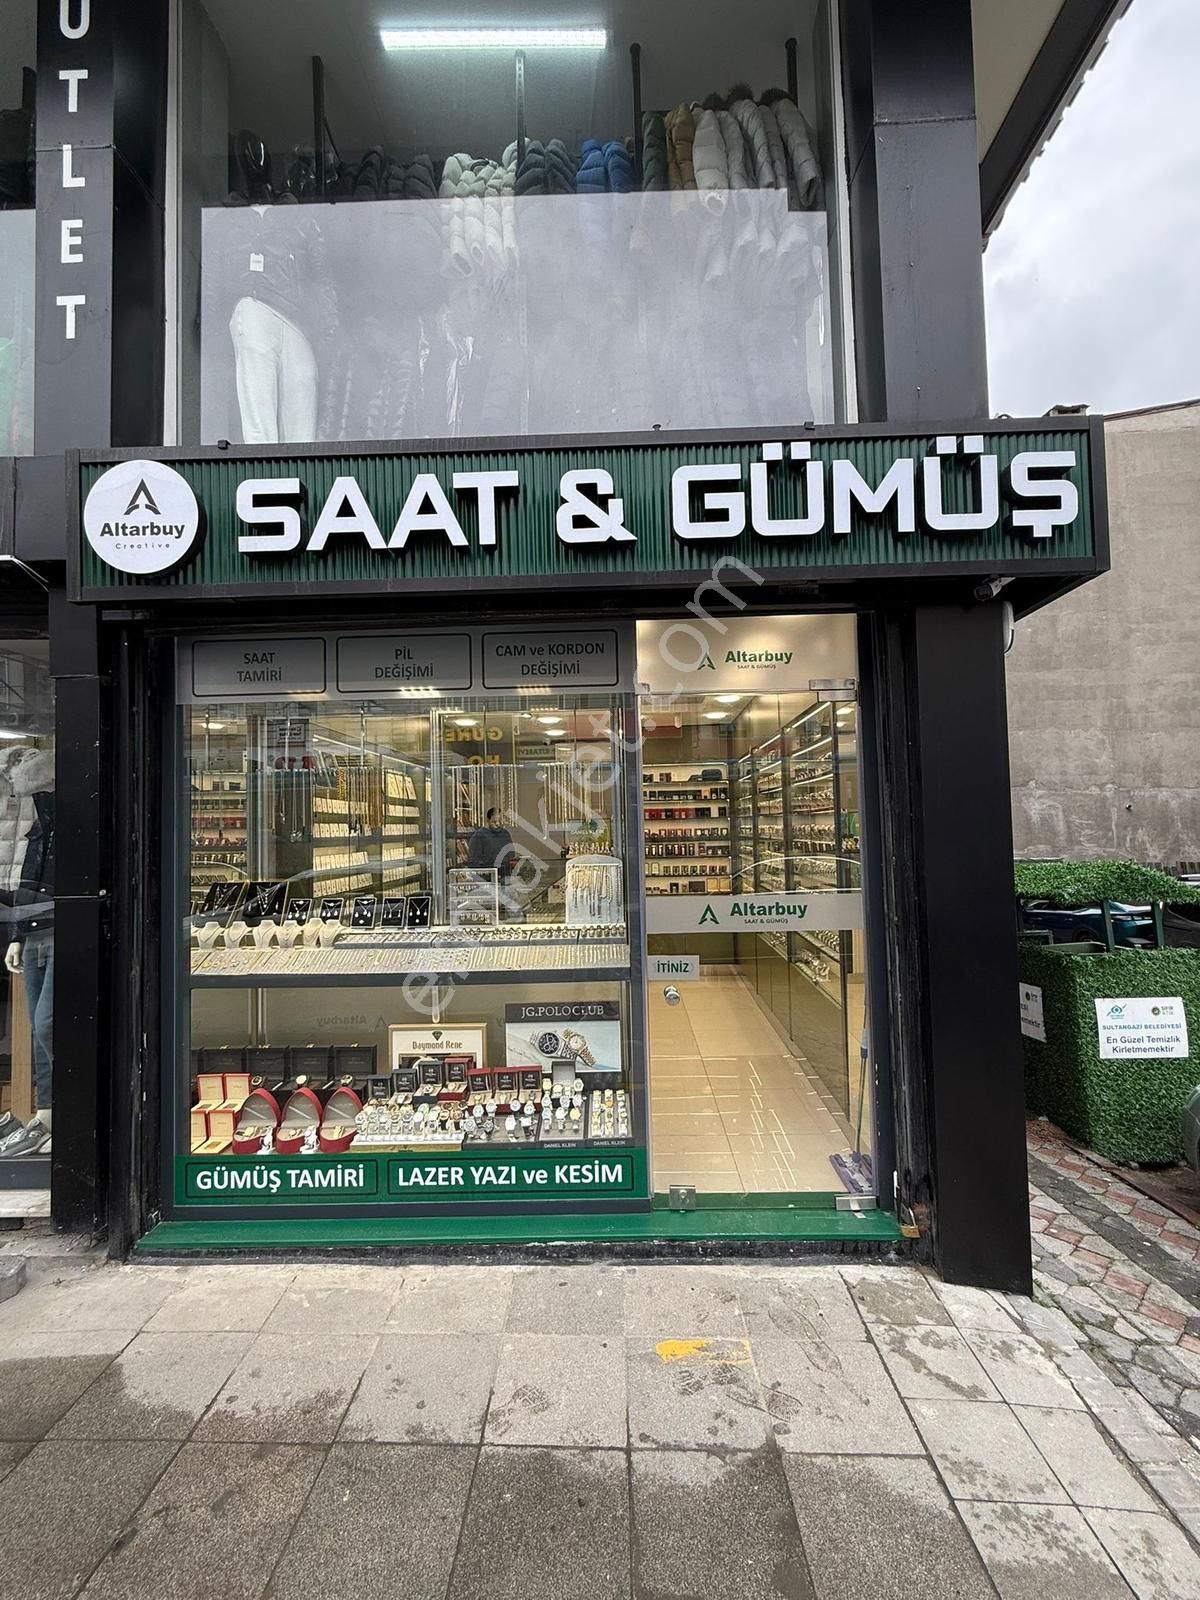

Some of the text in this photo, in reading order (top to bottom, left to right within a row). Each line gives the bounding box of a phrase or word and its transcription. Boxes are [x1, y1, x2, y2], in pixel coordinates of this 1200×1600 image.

[236, 435, 1079, 553] SAAT & GÜMÜŞ
[100, 522, 185, 539] Altarbuy
[115, 542, 170, 550] Creative
[395, 648, 413, 661] PİL
[495, 642, 605, 657] CAM ve KORDON
[725, 650, 793, 664] Altarbuy
[243, 652, 275, 665] SAAT
[237, 667, 282, 683] TAMİRİ
[375, 663, 433, 680] DEĞİŞİMİ
[520, 660, 580, 677] DEĞİŞİMİ
[730, 902, 807, 918] Altarbuy
[657, 961, 689, 973] İTİNİZ
[196, 1164, 364, 1193] GÜMÜŞ TAMİRİ
[398, 1160, 622, 1186] LAZER YAZI ve KESİM
